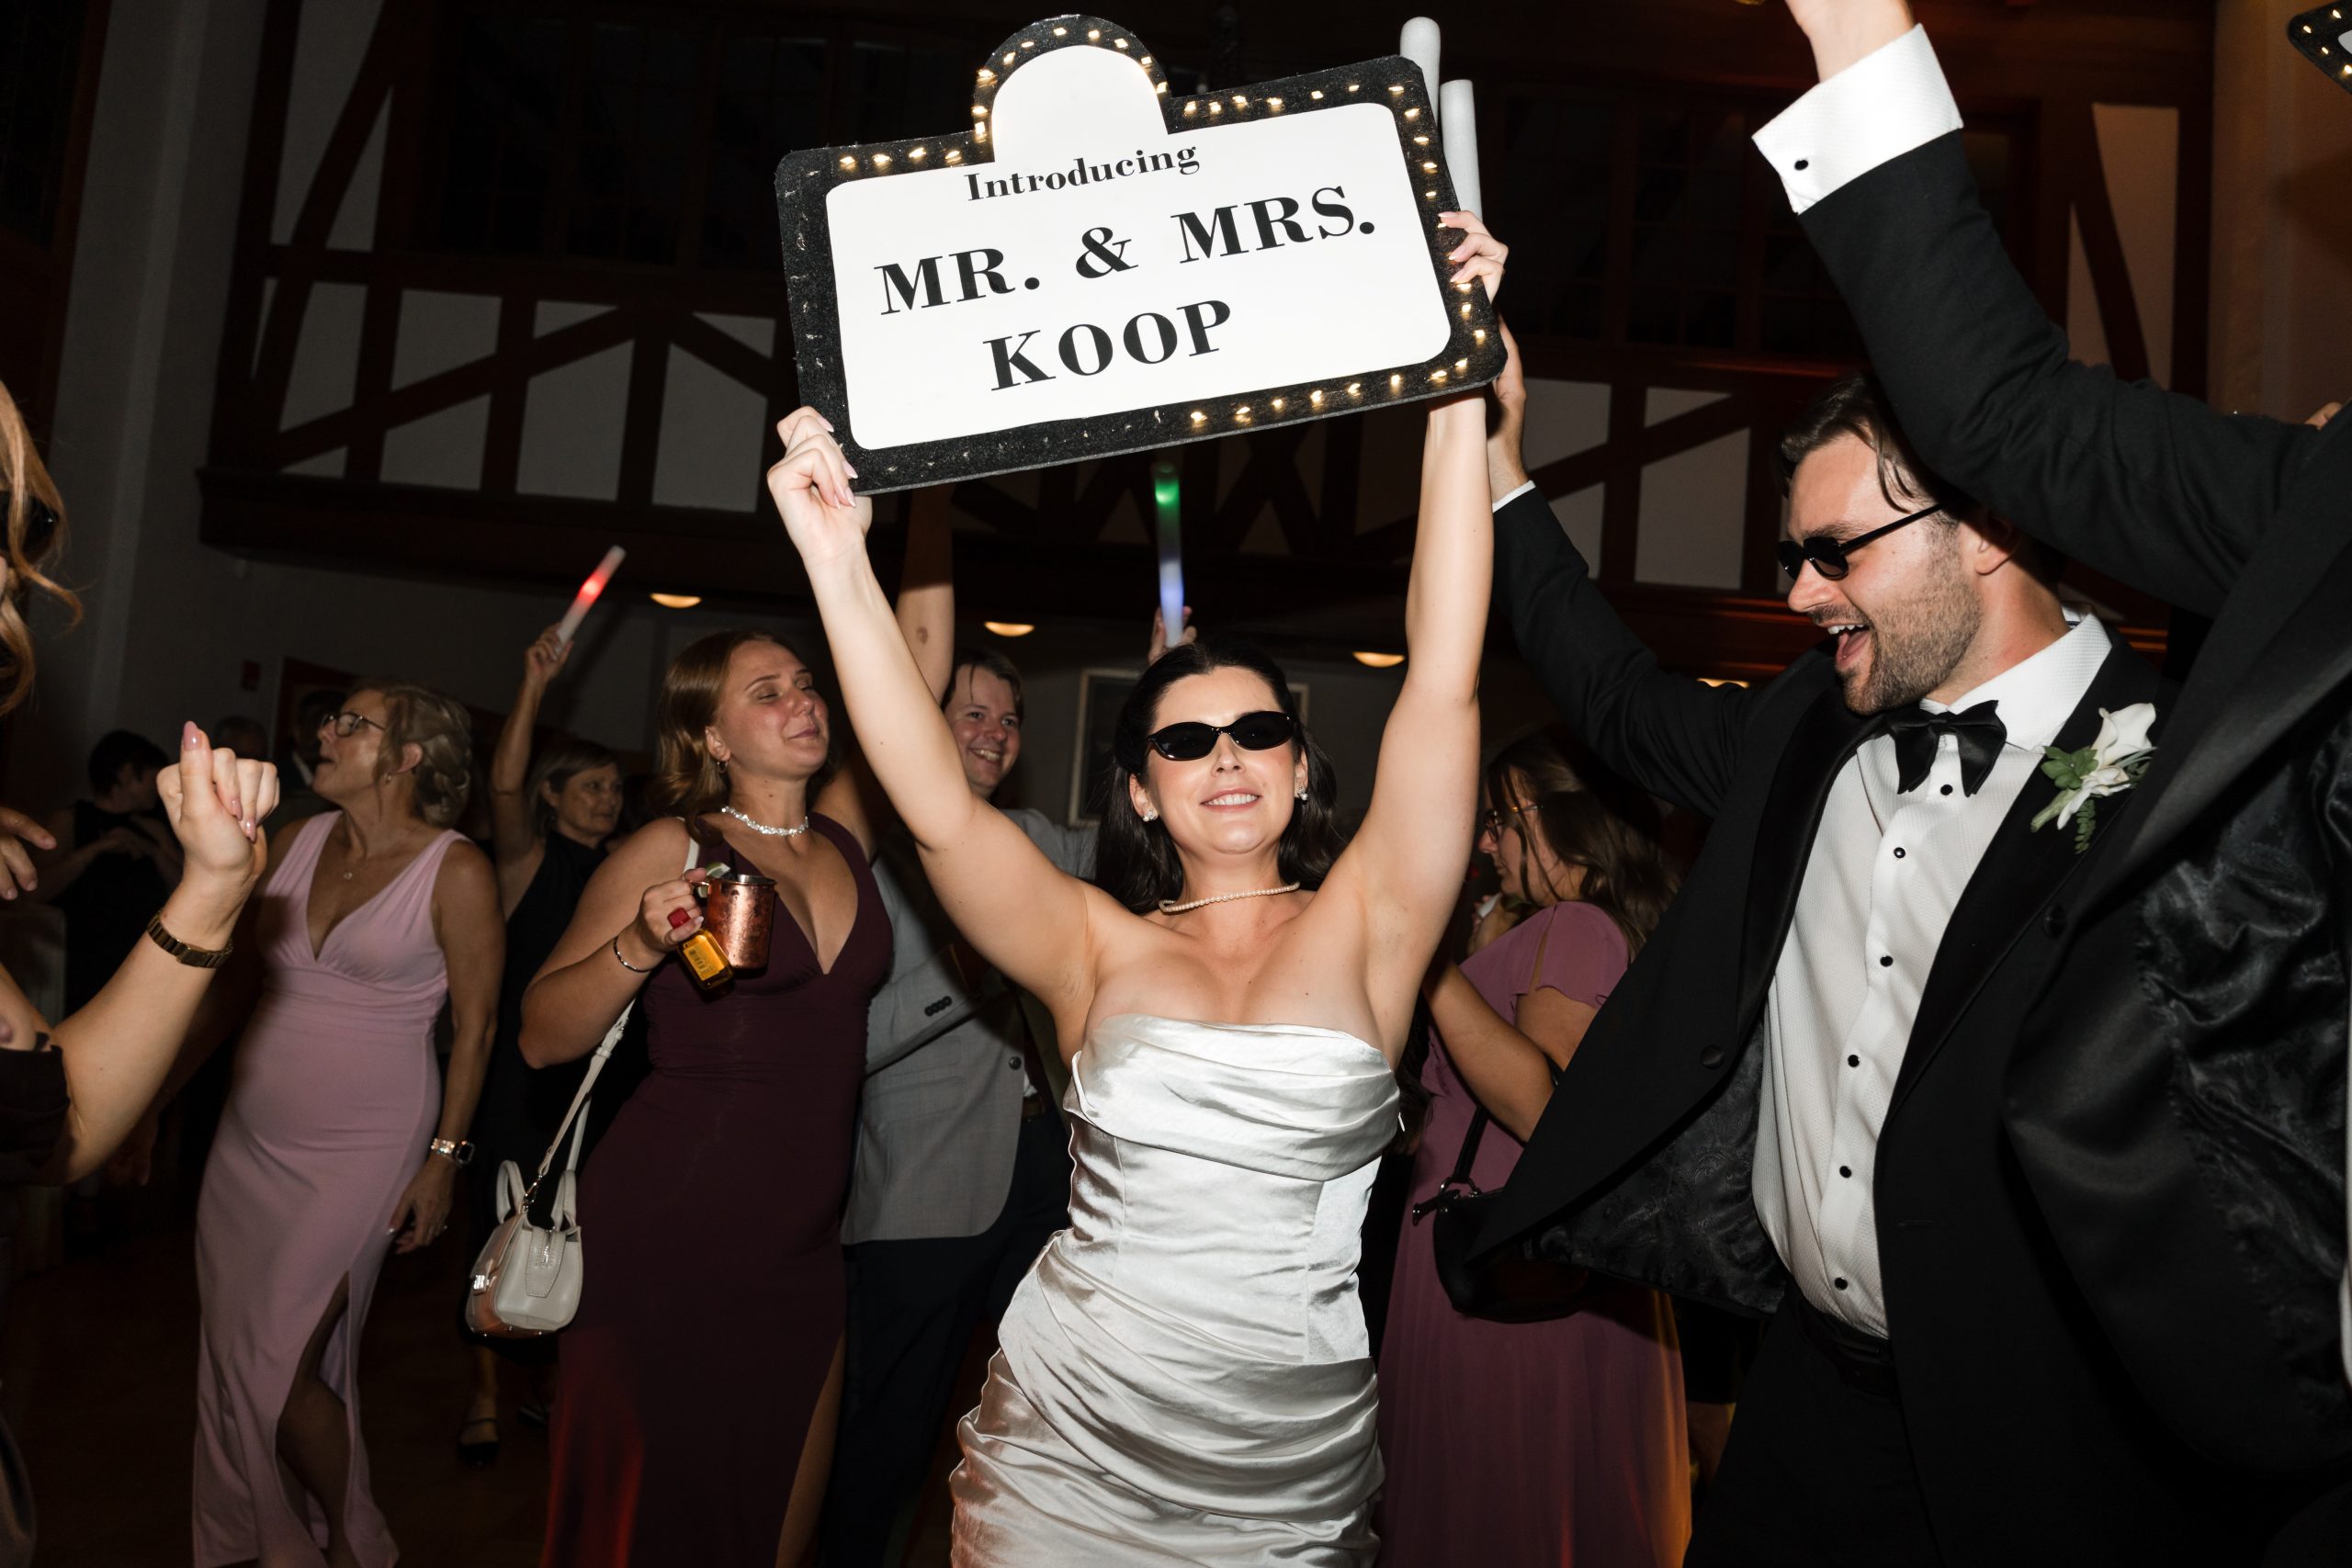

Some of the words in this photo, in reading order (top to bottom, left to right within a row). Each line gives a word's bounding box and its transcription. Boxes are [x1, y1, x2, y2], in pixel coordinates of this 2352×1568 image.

[964, 146, 1200, 201] Introducing
[874, 248, 1040, 316] MR.
[1075, 227, 1139, 279] &
[1170, 186, 1375, 264] MRS.
[982, 299, 1231, 391] KOOP
